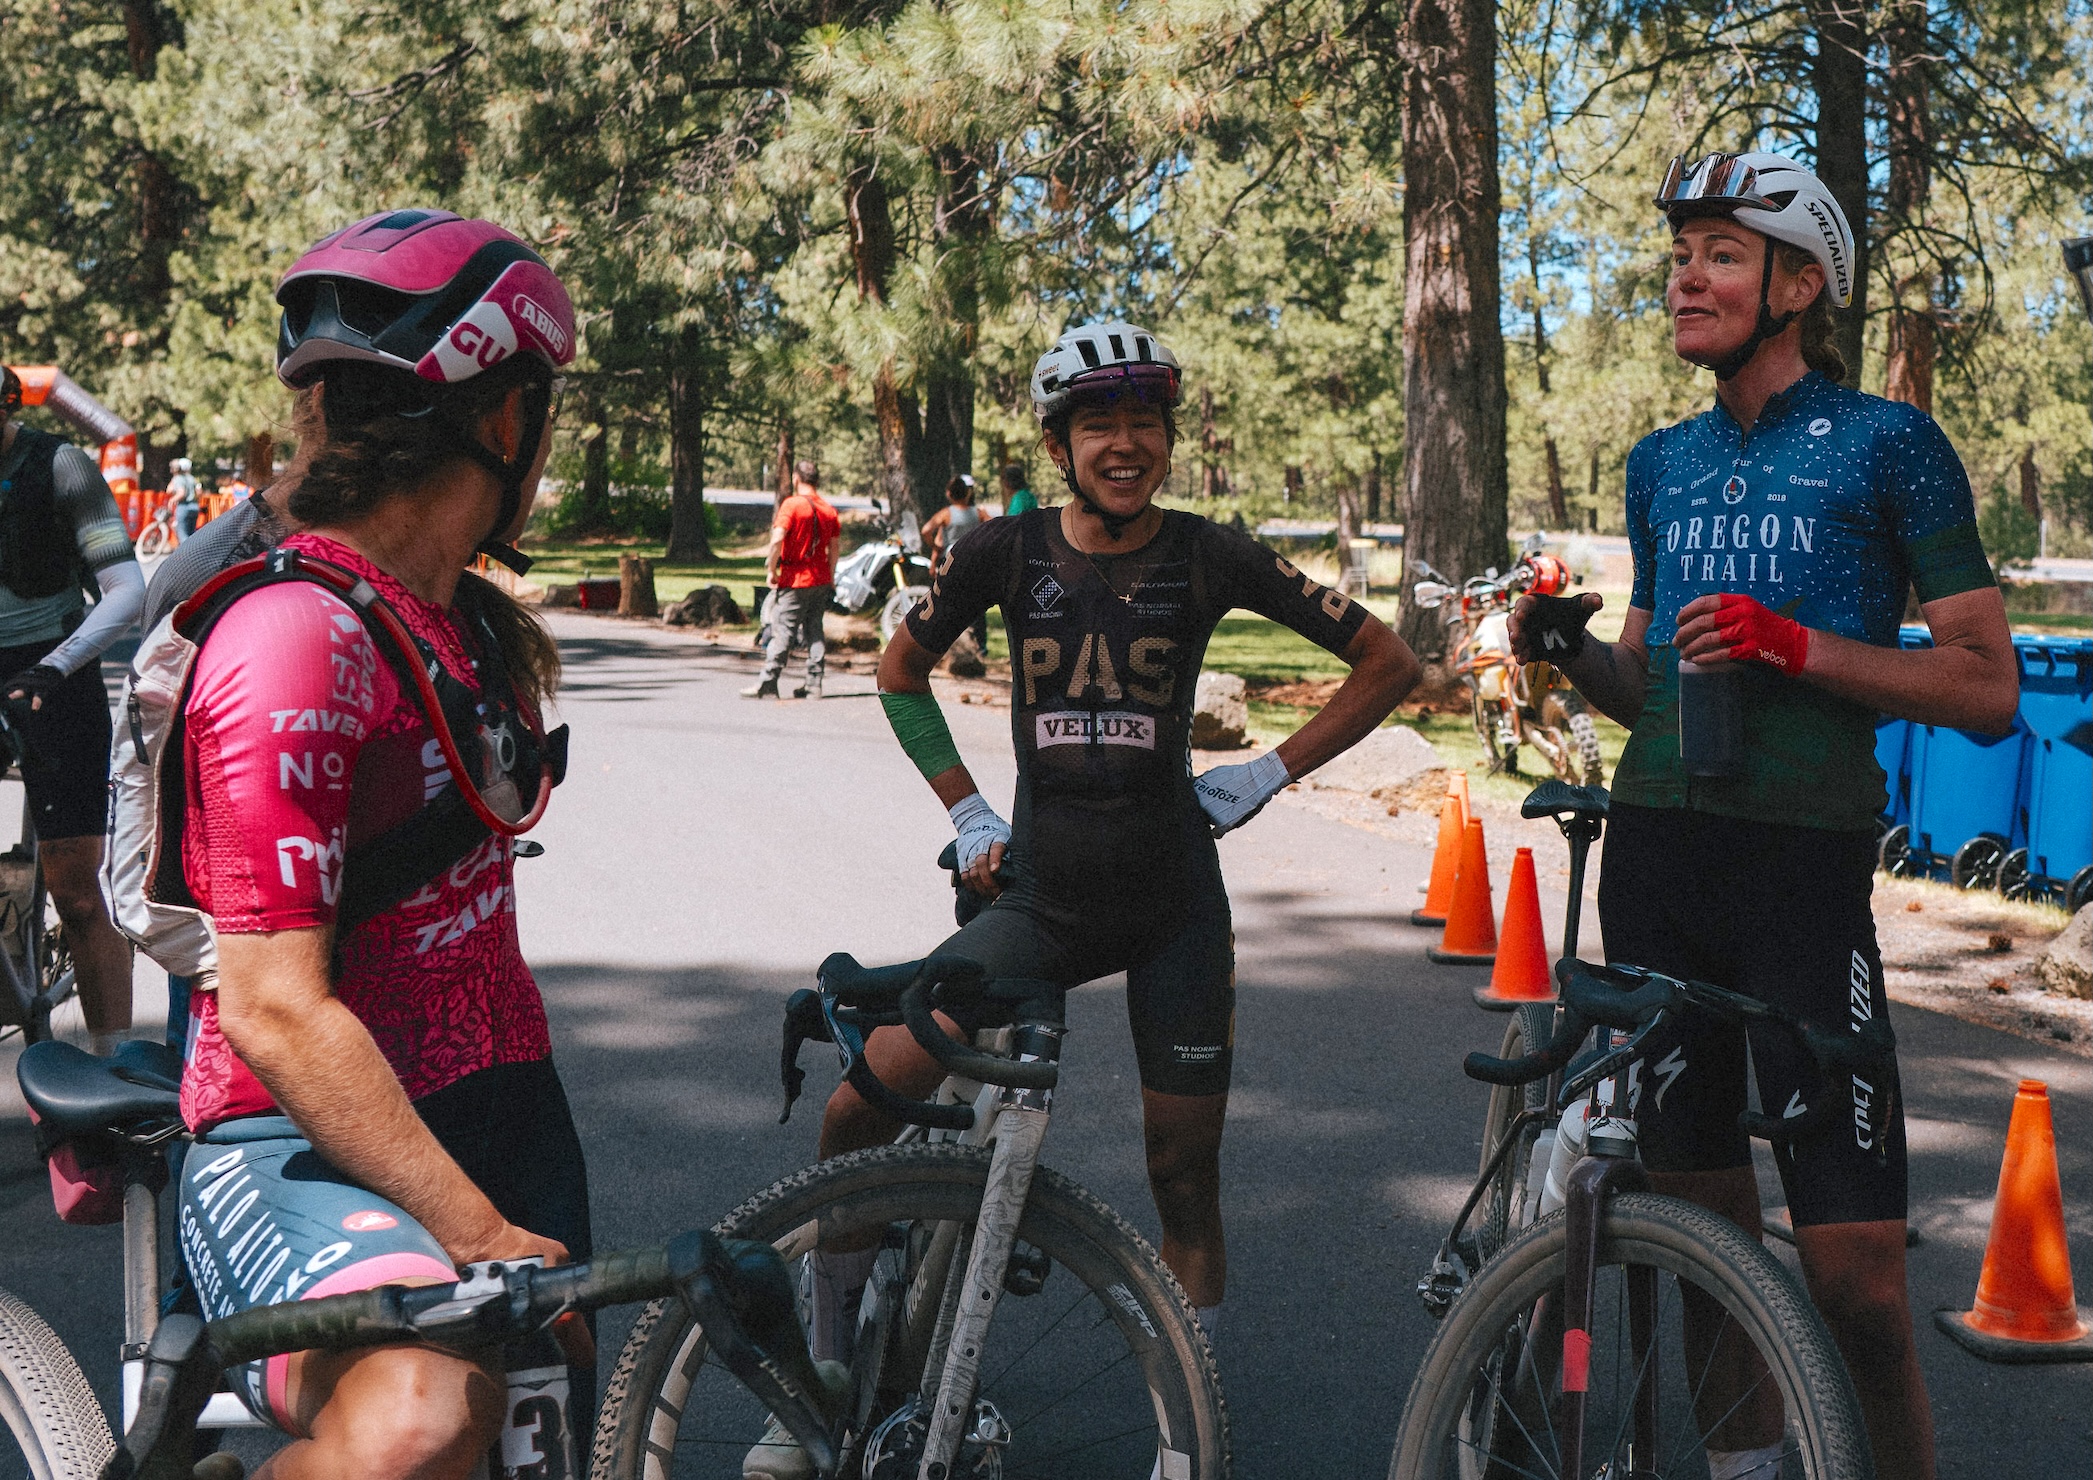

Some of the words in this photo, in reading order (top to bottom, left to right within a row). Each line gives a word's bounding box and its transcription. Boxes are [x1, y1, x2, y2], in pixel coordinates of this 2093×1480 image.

[1803, 201, 1849, 297] SPECIALIZED
[450, 322, 507, 369] GU
[520, 301, 566, 350] ABUS
[1667, 486, 1683, 496] The
[1690, 468, 1719, 489] Grand
[1763, 464, 1775, 474] of
[1789, 475, 1829, 488] Gravel
[1767, 493, 1787, 502] 2018
[1667, 513, 1817, 553] OREGON
[1681, 553, 1783, 584] TRAIL
[1023, 633, 1178, 706] PAS
[1758, 649, 1787, 667] velocio
[1190, 1045, 1222, 1053] NORMAL
[192, 1148, 260, 1240] PALO
[226, 1211, 292, 1303] ALTO
[183, 1204, 223, 1304] CONCRETE
[218, 1294, 239, 1319] AN
[1112, 1282, 1158, 1338] ZIPP
